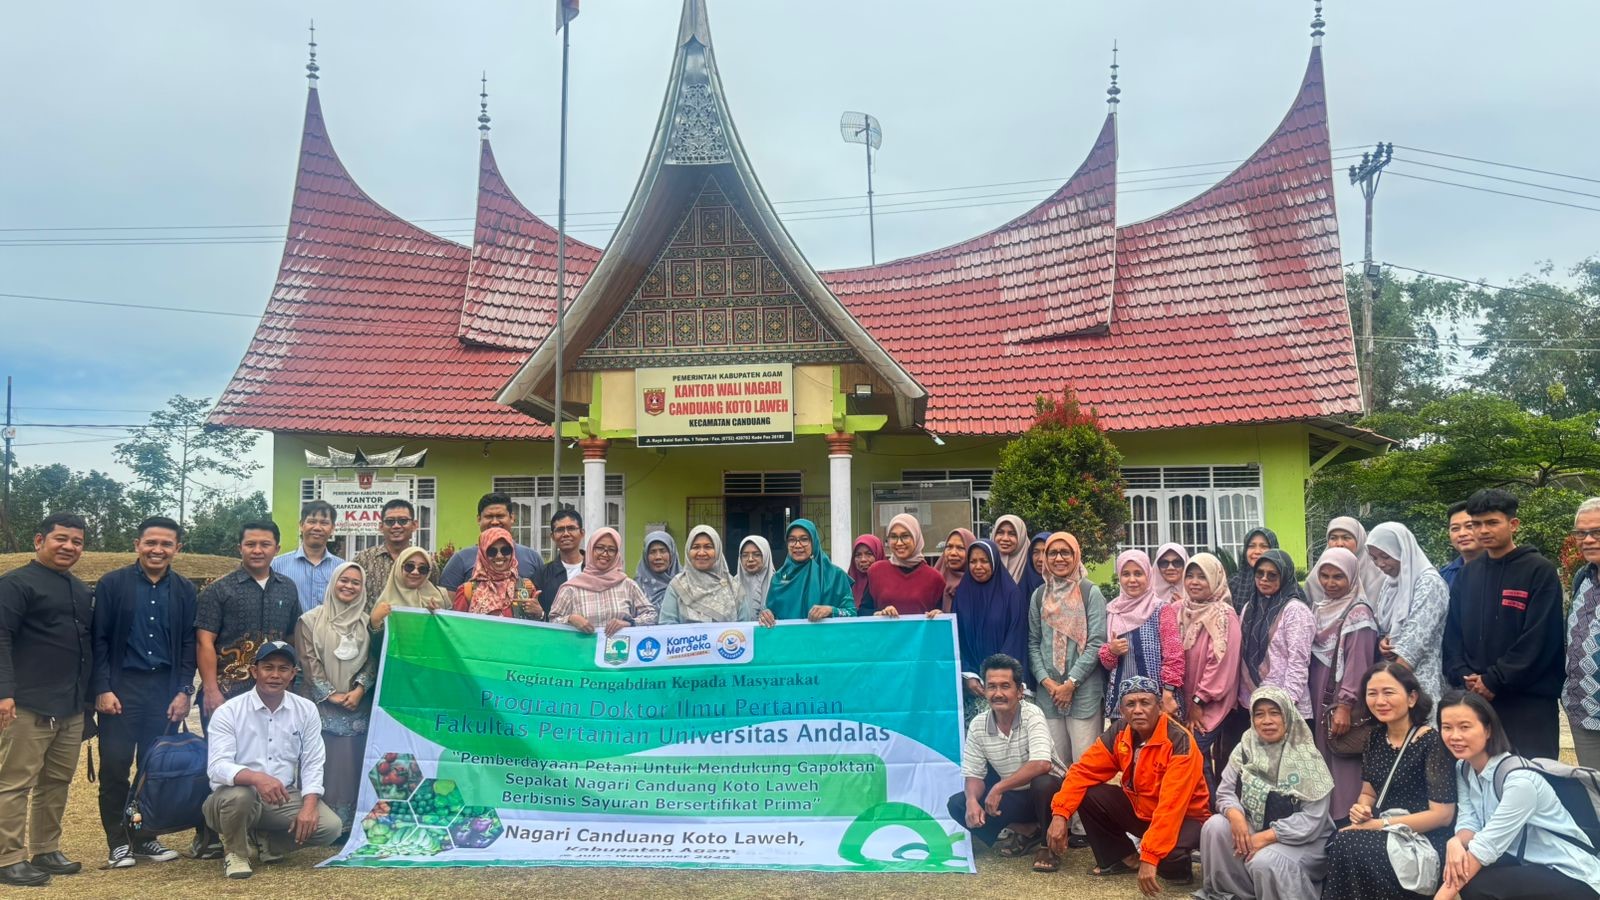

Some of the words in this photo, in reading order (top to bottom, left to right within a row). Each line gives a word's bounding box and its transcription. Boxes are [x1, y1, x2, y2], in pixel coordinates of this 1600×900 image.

[673, 373, 717, 381] PEMERINTAH
[719, 372, 760, 380] KABUPATEN
[675, 384, 714, 398] KANTOR
[717, 383, 742, 396] WALI
[744, 381, 782, 395] NAGARI
[669, 401, 723, 415] CANDUANG
[726, 401, 750, 414] KOTO
[754, 399, 788, 413] LAWEH
[689, 418, 731, 427] KECAMATAN
[732, 417, 771, 426] CANDUANG
[345, 511, 382, 520] KAN
[666, 633, 708, 646] Kampus
[666, 642, 711, 655] Merdeka
[506, 669, 574, 688] Kegiatan
[579, 677, 666, 693] Pengabdian
[672, 675, 726, 691] Kepada
[732, 673, 820, 688] Masyarakat
[480, 690, 580, 716] Program
[590, 700, 668, 719] Doktor
[677, 699, 726, 718] Ilmu
[735, 697, 844, 716] Pertanian
[435, 713, 528, 738] Fakultas
[538, 722, 649, 745] Pertanian
[659, 724, 788, 744] Universitas
[796, 722, 890, 743] Andalas
[585, 760, 638, 773] Petani
[643, 762, 692, 774] Untuk
[698, 761, 791, 775] Mendukung
[797, 760, 875, 775] Gapoktan
[505, 773, 568, 788] Sepakat
[574, 777, 630, 792] Nagari
[635, 779, 717, 795] Canduang
[723, 780, 760, 792] Koto
[766, 779, 819, 792] Laweh
[502, 791, 576, 807] Berbisnis
[581, 795, 649, 810] Sayuran
[655, 798, 758, 811] Bersertifikat
[504, 825, 571, 843] Nagari
[576, 828, 675, 846] Canduang
[682, 831, 728, 845] Koto
[734, 831, 805, 847] Laweh,
